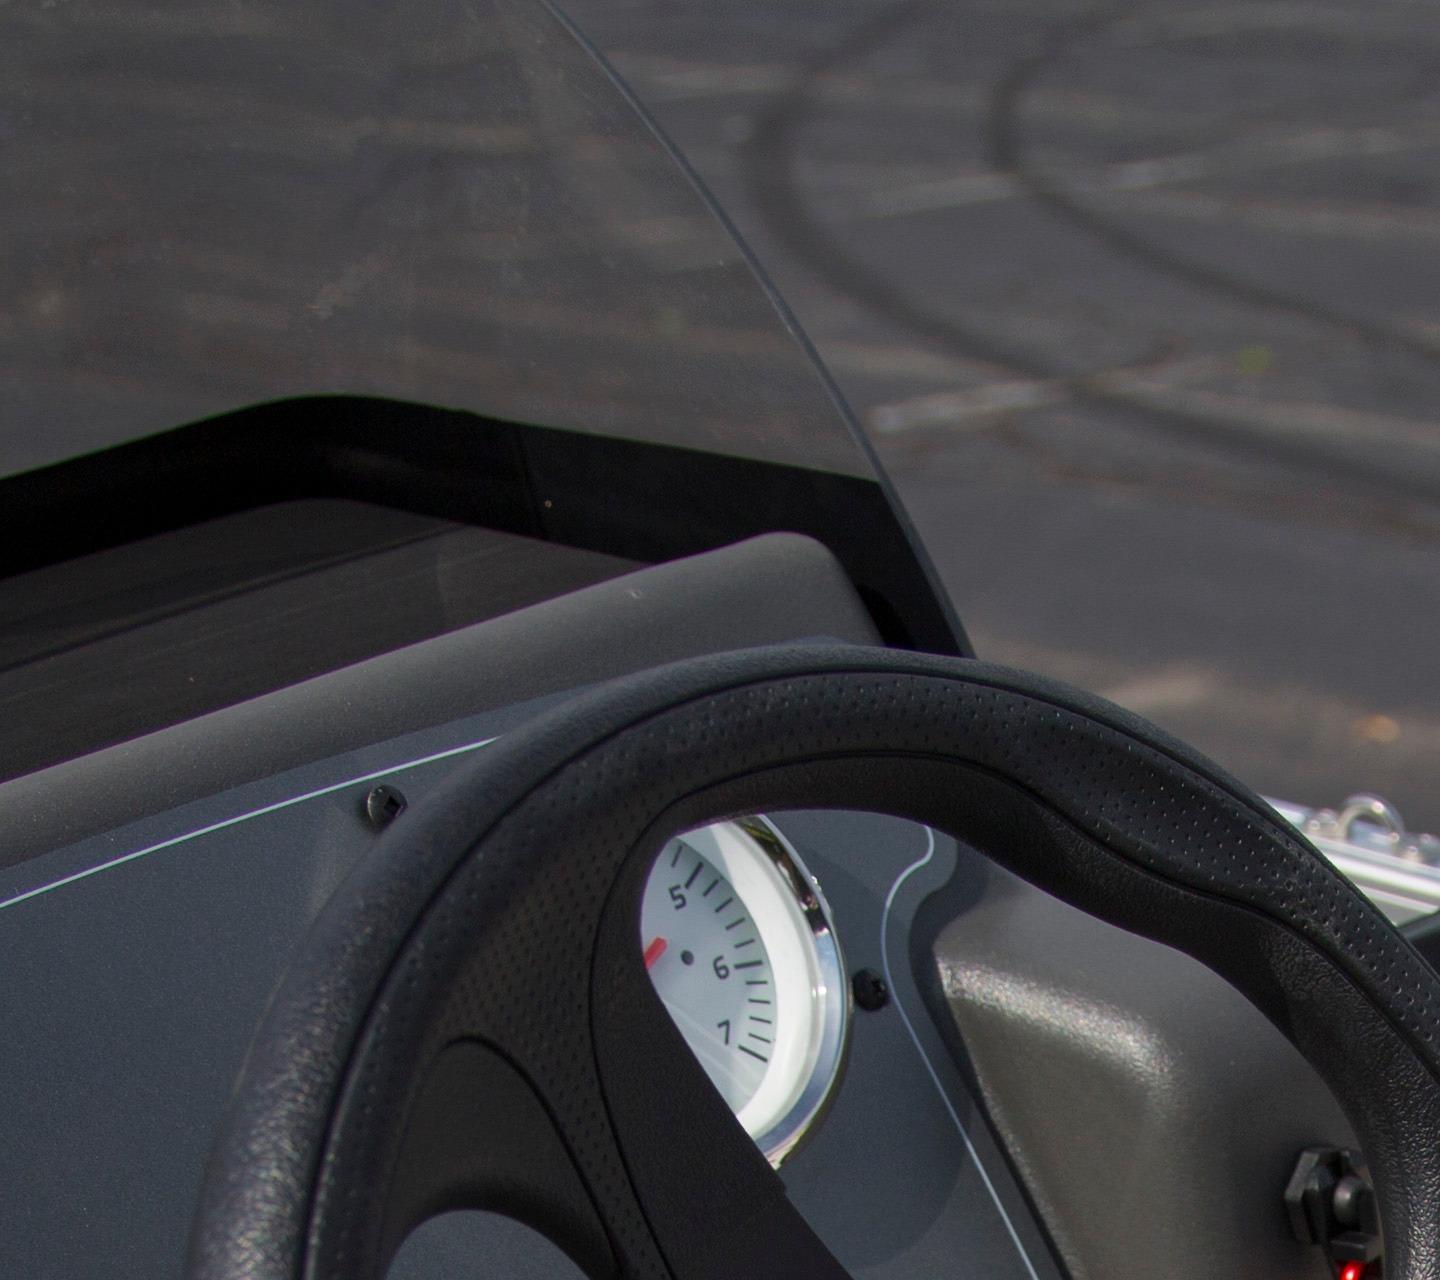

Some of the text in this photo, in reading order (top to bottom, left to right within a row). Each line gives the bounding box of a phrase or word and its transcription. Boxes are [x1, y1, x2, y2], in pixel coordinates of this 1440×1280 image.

[668, 883, 688, 910] 5
[713, 956, 731, 981] 6
[716, 1020, 733, 1045] 7
